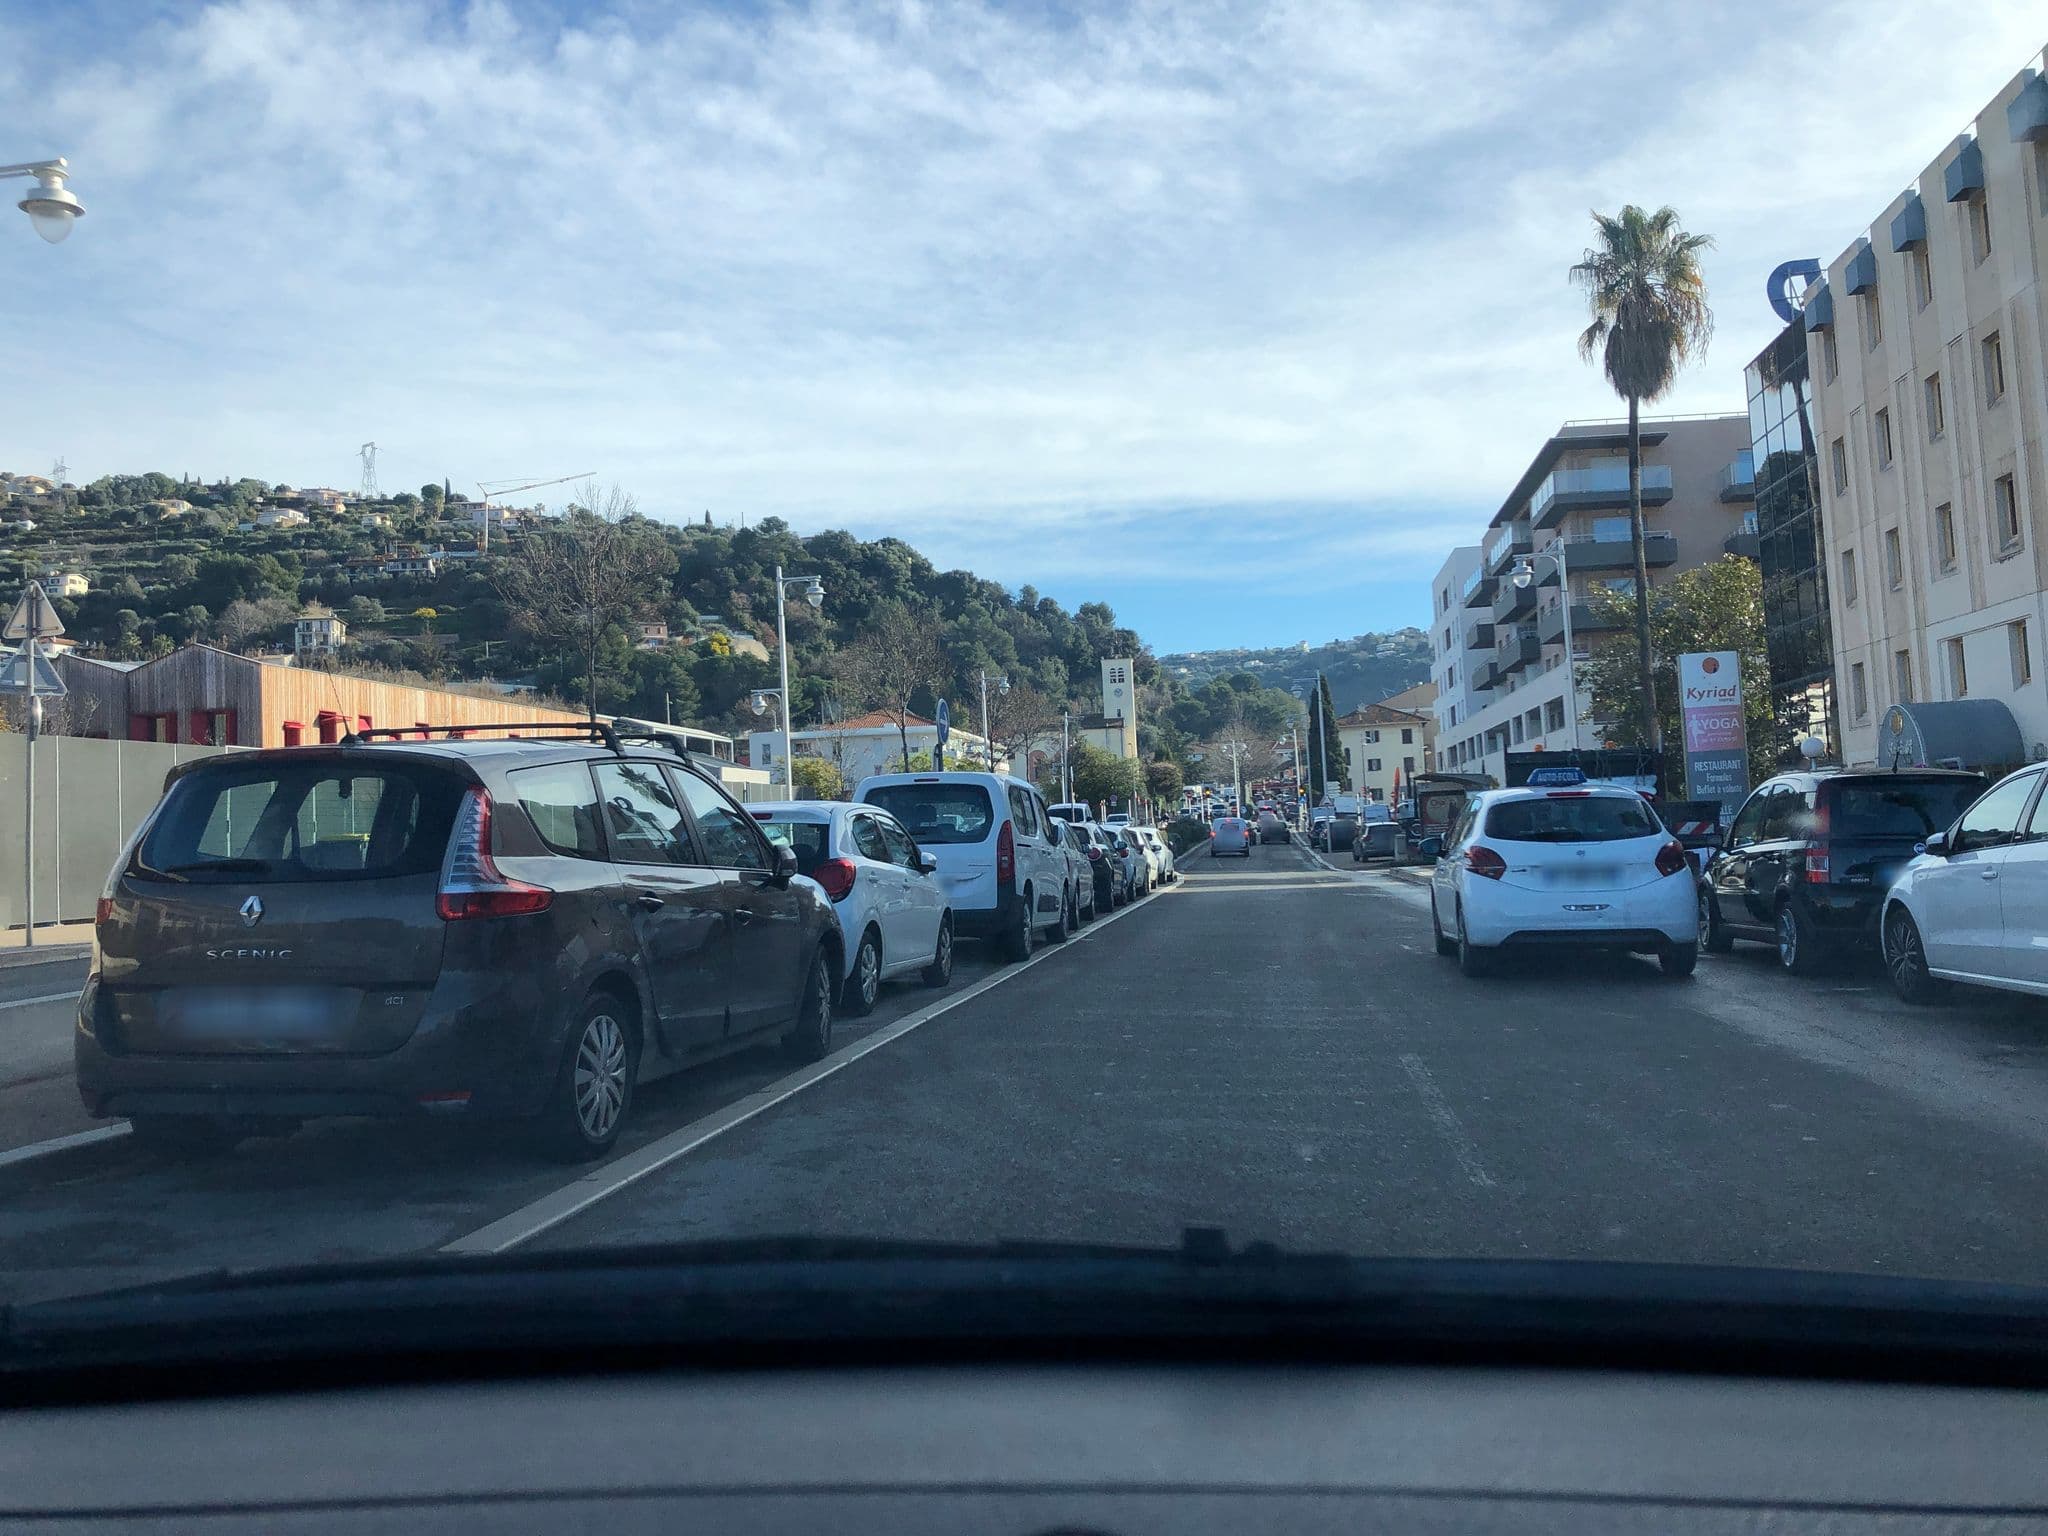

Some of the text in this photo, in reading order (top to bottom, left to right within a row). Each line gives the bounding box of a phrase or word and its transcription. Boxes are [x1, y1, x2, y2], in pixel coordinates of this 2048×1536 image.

[1687, 685, 1737, 702] Kyriad
[1701, 717, 1740, 730] YOGA
[1694, 760, 1741, 772] RESTAURANT
[206, 949, 293, 960] SCENIC
